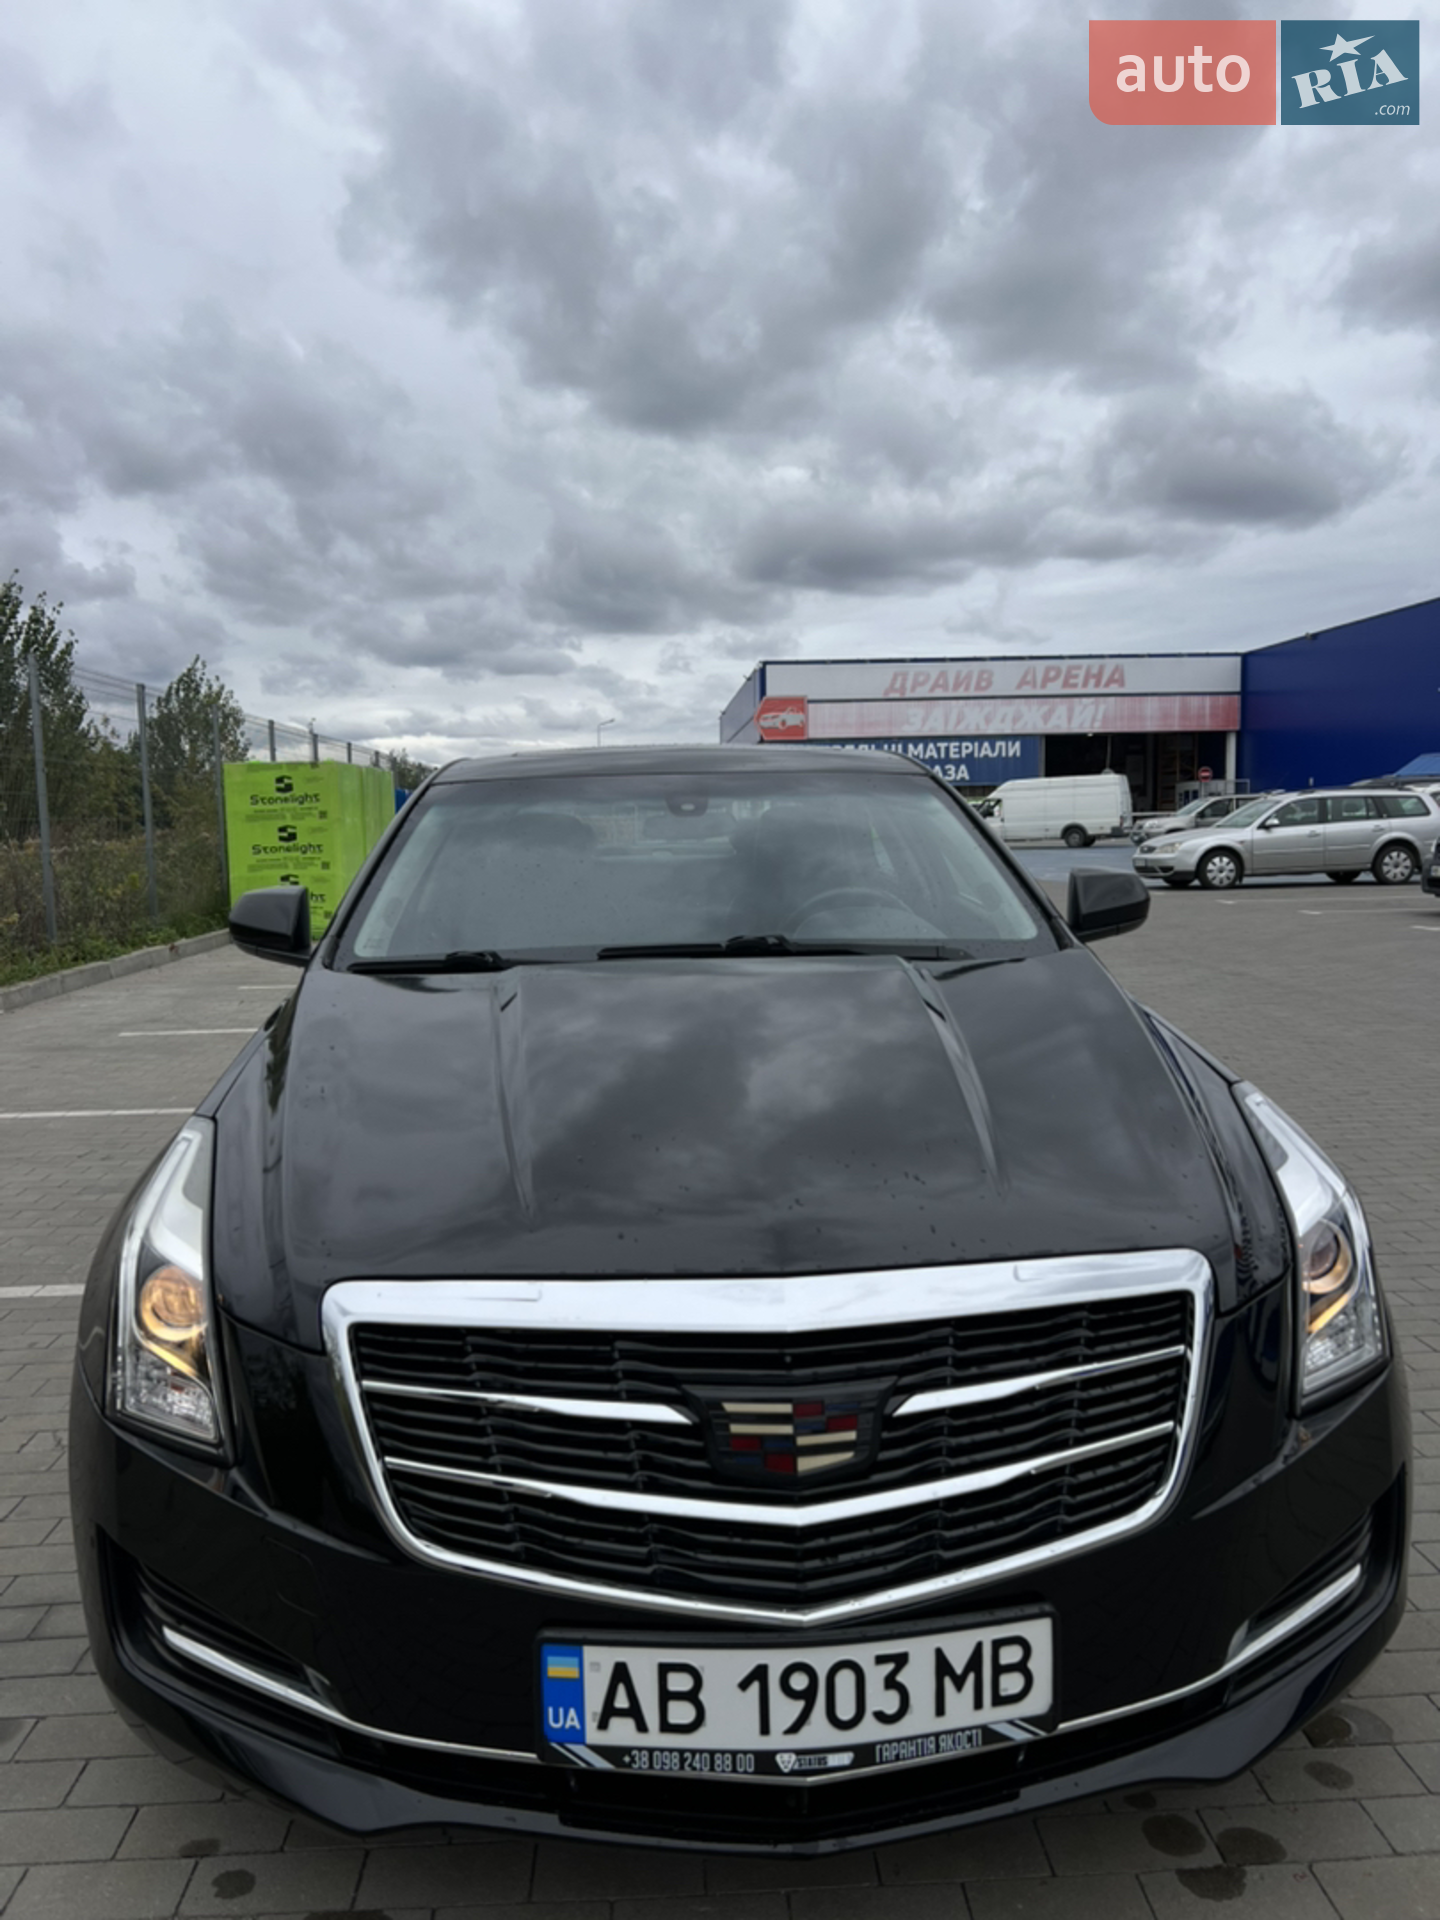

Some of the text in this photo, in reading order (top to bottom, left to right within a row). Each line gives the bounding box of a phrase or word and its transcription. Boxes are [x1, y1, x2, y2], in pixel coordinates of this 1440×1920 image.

[1015, 664, 1127, 690] АРЕНА
[907, 740, 1021, 759] МАТЕРІАЛИ
[933, 764, 970, 780] АЗА
[250, 792, 320, 806] Stonelight
[252, 842, 323, 855] Stonelight
[597, 1634, 1034, 1736] AB 1903 MB
[548, 1707, 581, 1731] UA
[875, 1728, 983, 1764] ГАРАНТІЯ ЯКОСТІ
[622, 1750, 755, 1773] +38 098 240 88 00
